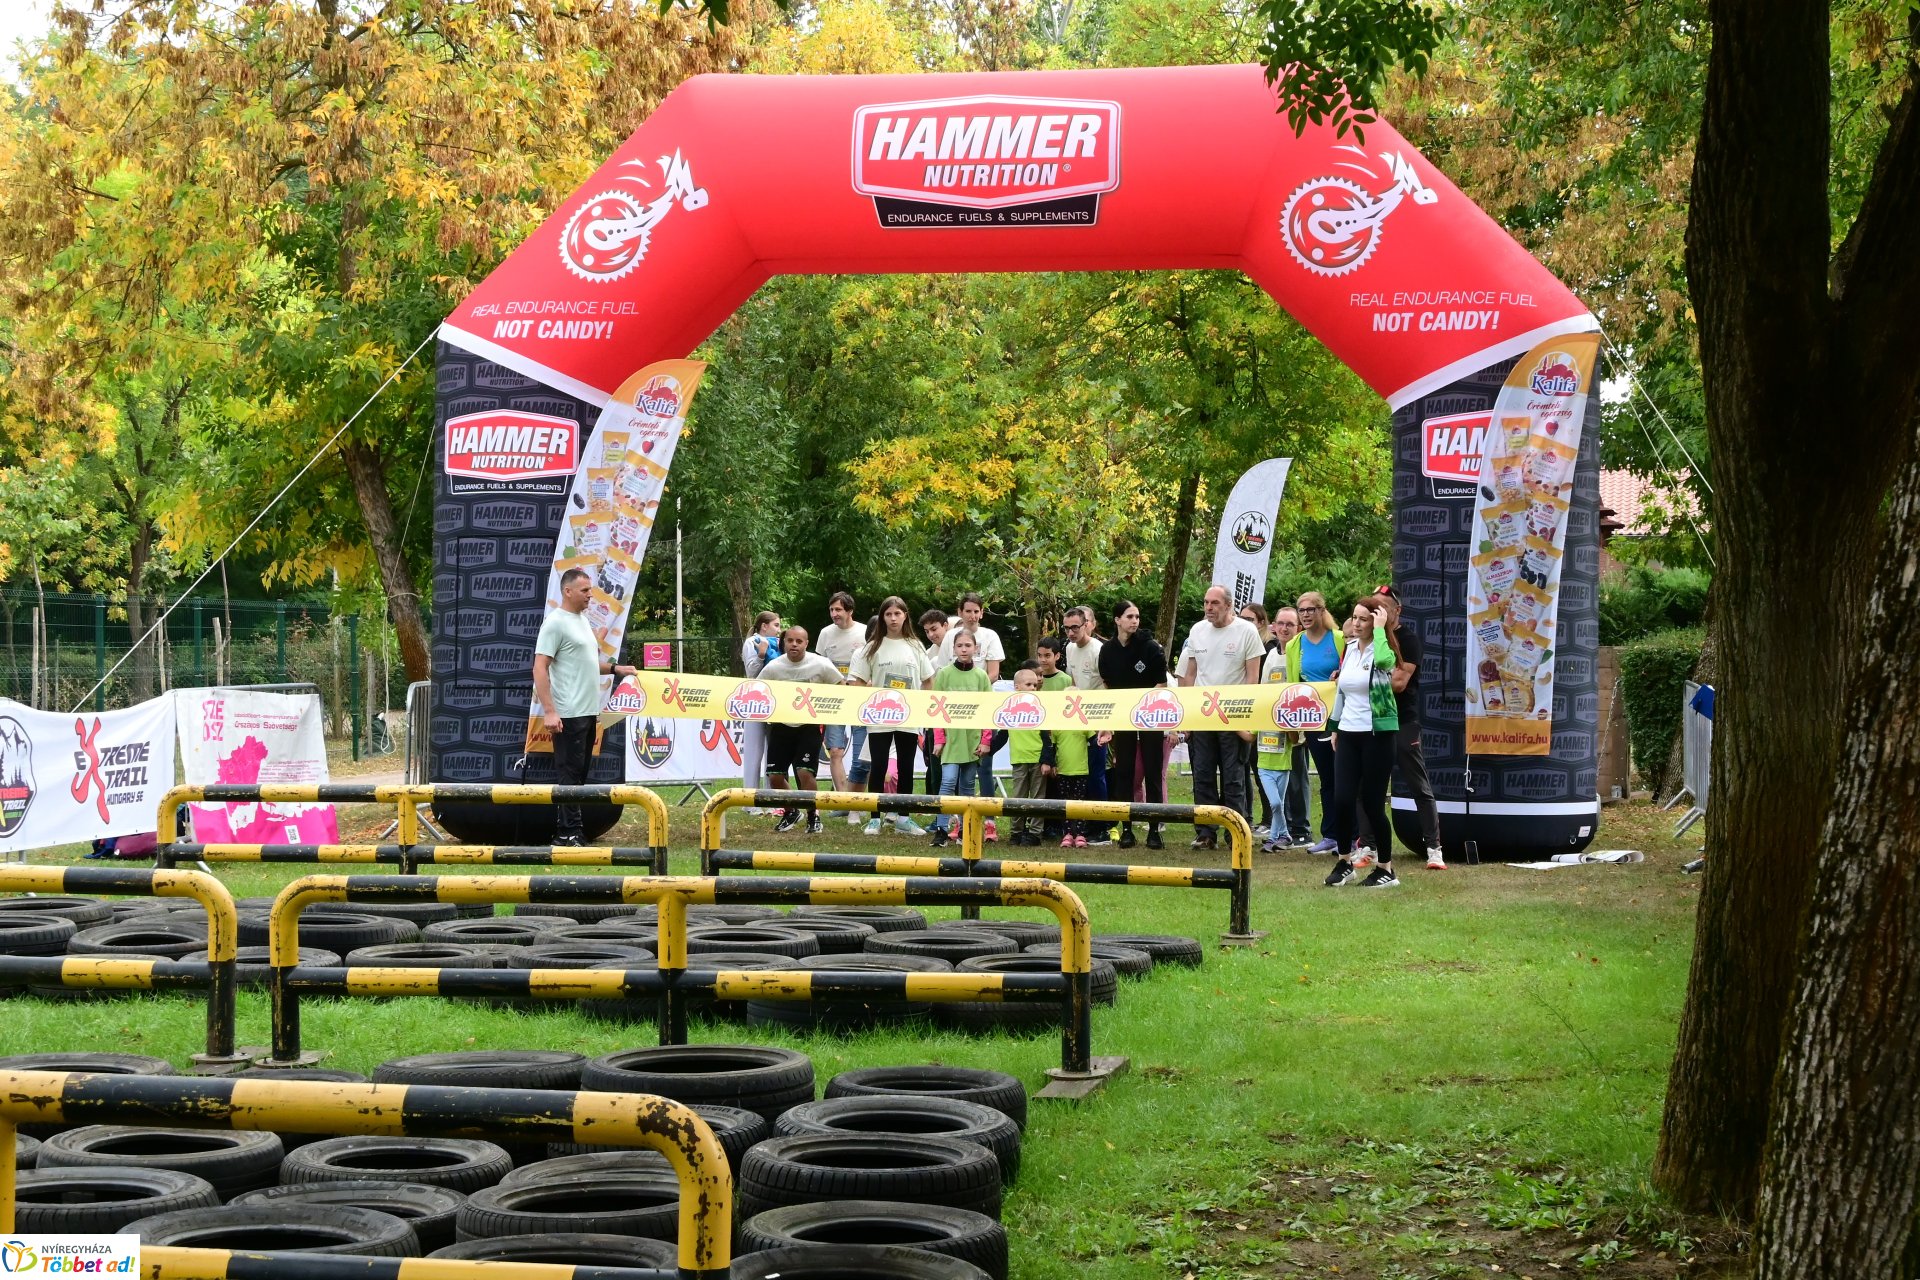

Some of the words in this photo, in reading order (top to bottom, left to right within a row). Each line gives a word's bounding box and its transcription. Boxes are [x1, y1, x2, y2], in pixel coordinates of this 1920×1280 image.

[869, 115, 1101, 160] HAMMER
[924, 164, 1058, 186] NUTRITION
[888, 214, 953, 222] ENDURANCE
[959, 213, 992, 222] FUELS
[998, 213, 1005, 221] &
[1010, 212, 1088, 221] SUPPLEMENTS
[1350, 293, 1388, 307] REAL
[1393, 291, 1495, 306] ENDURANCE
[1499, 292, 1537, 307] FUEL
[471, 304, 501, 318] REAL
[505, 301, 597, 314] ENDURANCE
[602, 302, 639, 315] FUEL
[493, 320, 534, 338] NOT
[537, 320, 614, 339] CANDY!
[1372, 312, 1414, 332] NOT
[1418, 310, 1500, 331] CANDY!
[1531, 373, 1576, 396] Kalifa
[636, 393, 677, 416] Kalifa
[450, 426, 570, 455] HAMMER
[1431, 427, 1488, 457] HAM
[471, 455, 545, 469] NUTRITION
[516, 483, 562, 491] SUPPLEMENTS
[474, 506, 534, 520] HAMMER
[1403, 510, 1448, 524] HAMMER
[474, 577, 533, 590] HAMMER
[472, 648, 532, 662] HAMMER
[607, 694, 641, 712] alifa
[662, 678, 712, 712] EXTREME
[792, 686, 845, 718] EXTREME
[729, 698, 770, 718] Kalifa
[862, 706, 904, 727] Kalifa
[927, 694, 980, 724] EXTREME
[1062, 694, 1116, 725] EXTREME
[1201, 690, 1256, 724] EXTREME
[996, 708, 1040, 728] Kalifa
[1134, 708, 1178, 728] Kalifa
[1276, 708, 1322, 728] Kalifa
[1472, 732, 1548, 744] www.kalifa.hu
[71, 717, 150, 824] EXTREME
[444, 756, 490, 770] HAMMER
[105, 766, 148, 790] TRAIL
[1506, 774, 1566, 788] HAMMER
[107, 792, 135, 806] HUNGARY
[136, 790, 144, 802] SE
